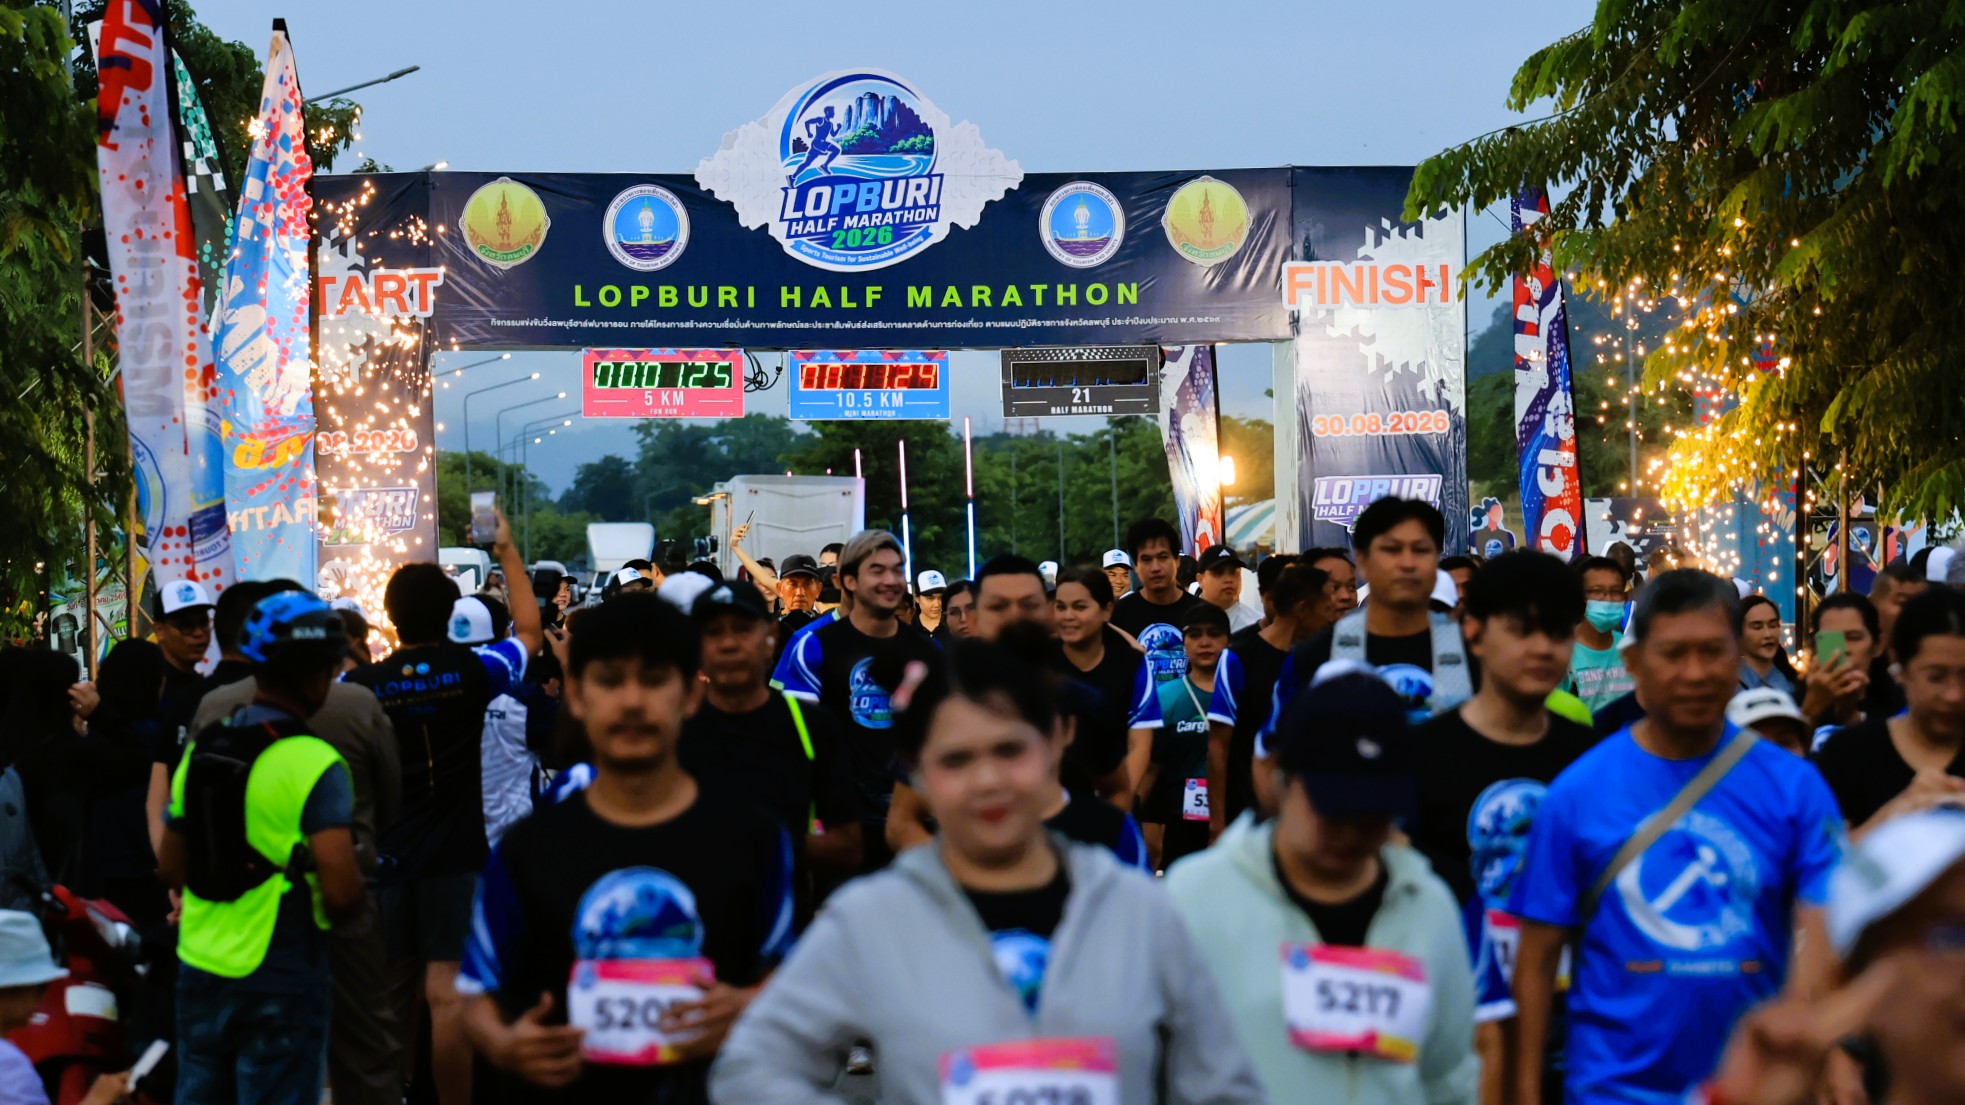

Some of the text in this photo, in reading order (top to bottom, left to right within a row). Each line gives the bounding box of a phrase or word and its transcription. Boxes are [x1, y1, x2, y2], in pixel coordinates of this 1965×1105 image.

[783, 175, 941, 220] LOPBURI
[790, 207, 938, 236] HALF MARATHON
[800, 235, 924, 263] Sports Tourism for Sustainable Well-being
[830, 225, 894, 250] 2026
[318, 272, 439, 316] TART
[575, 282, 1138, 308] LOPBURI HALF MARATHON
[1287, 264, 1450, 305] FINISH
[644, 390, 685, 406] 5 KM
[836, 392, 904, 408] 10.5 KM
[1071, 387, 1091, 404] 21
[861, 409, 896, 417] MARATHON
[1051, 405, 1113, 414] HALF MARATHON
[1312, 411, 1449, 436] 30.08.2026
[1319, 505, 1355, 517] HALF
[1176, 720, 1206, 734] Carg
[1316, 978, 1402, 1019] 5217
[593, 997, 666, 1032] 520
